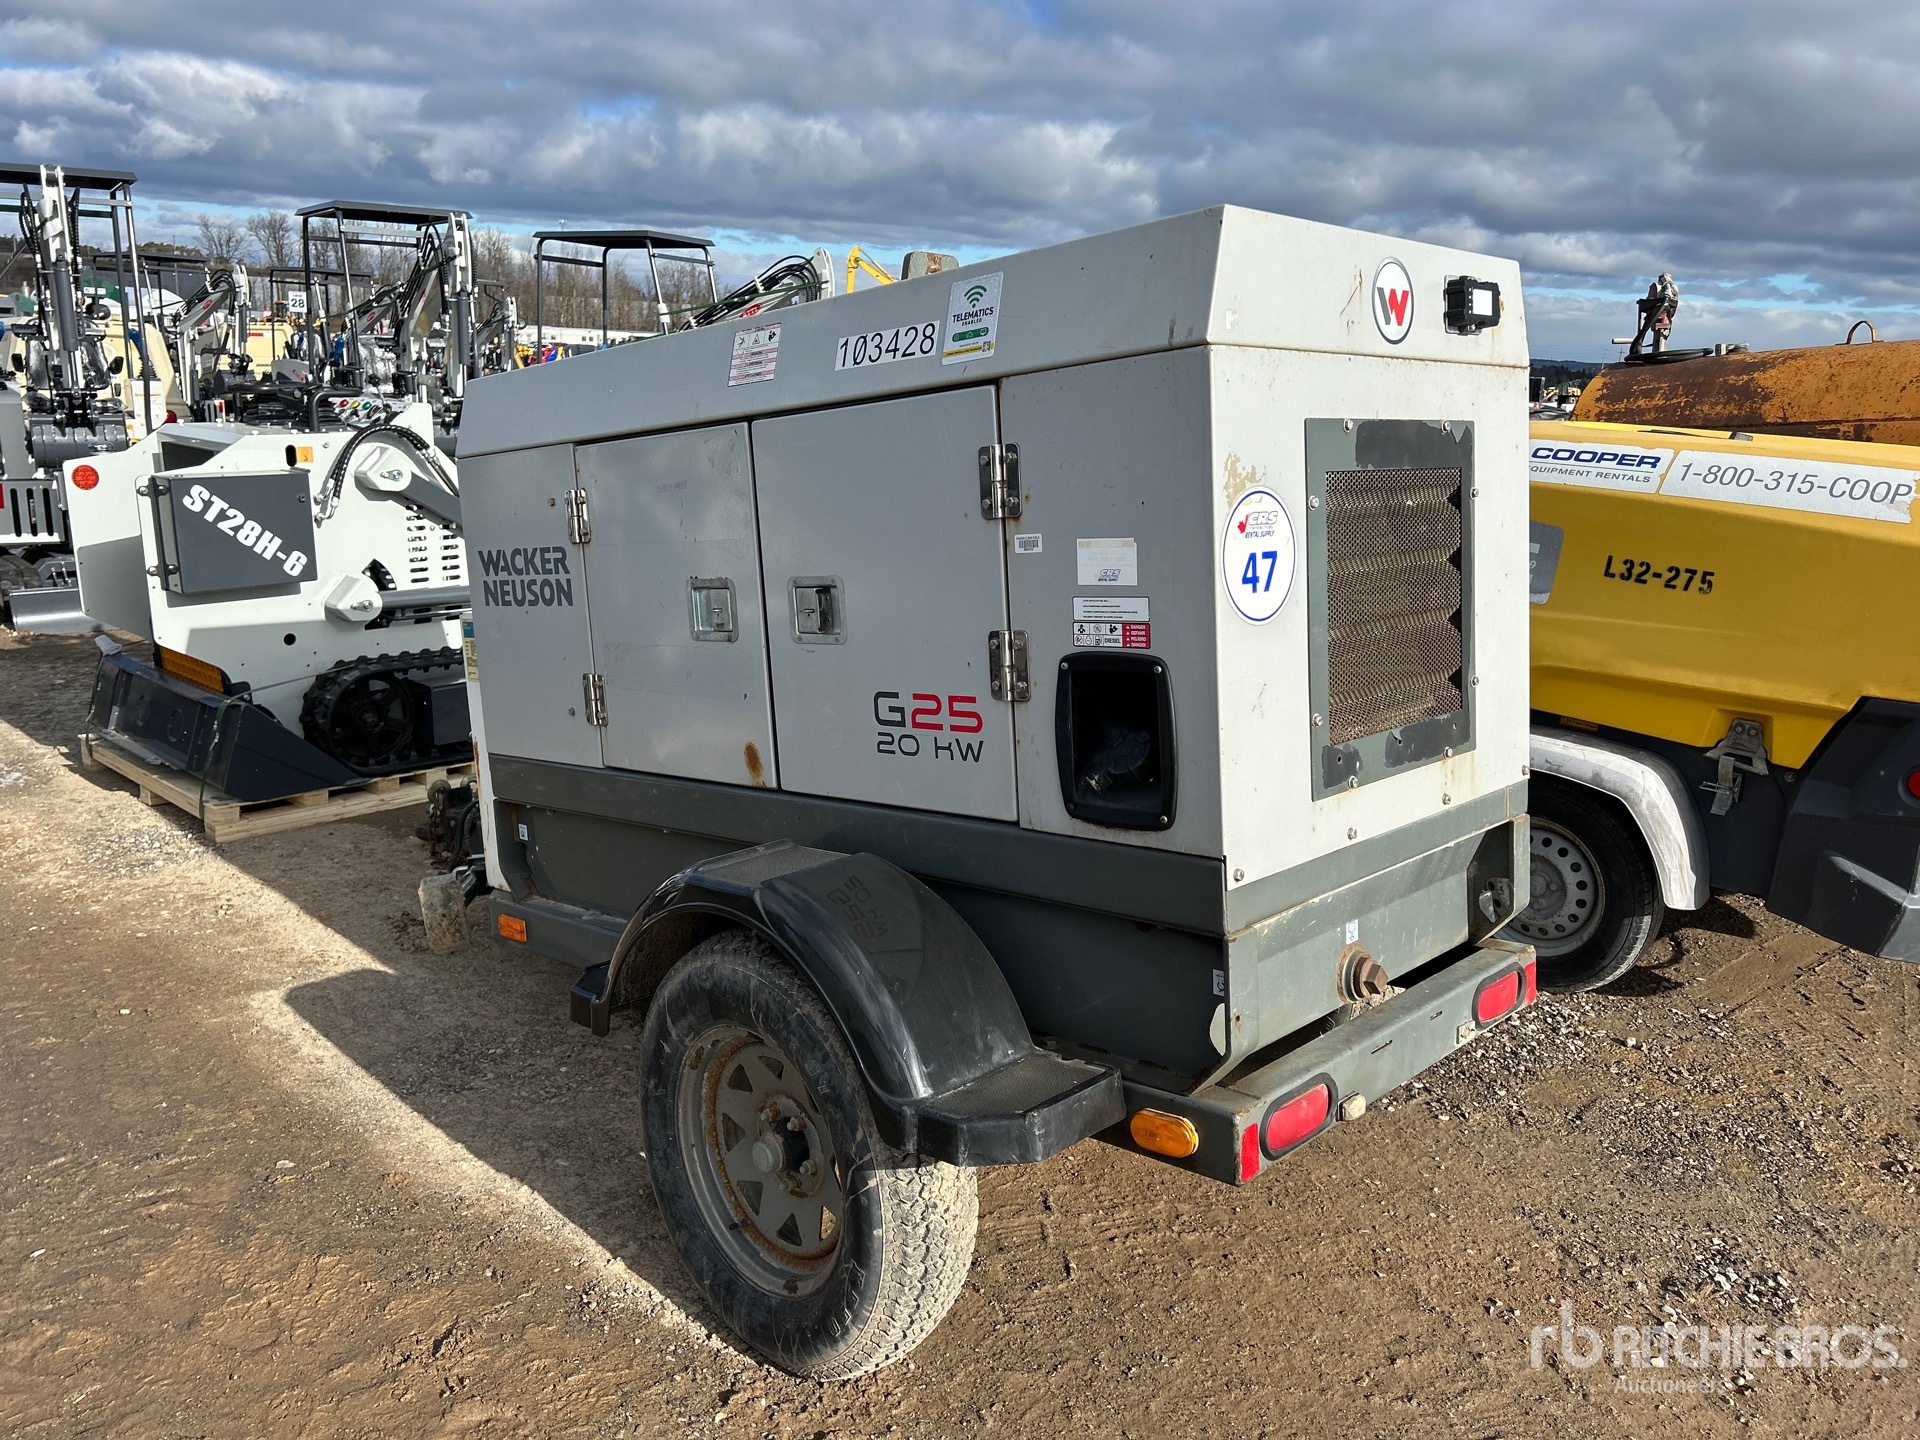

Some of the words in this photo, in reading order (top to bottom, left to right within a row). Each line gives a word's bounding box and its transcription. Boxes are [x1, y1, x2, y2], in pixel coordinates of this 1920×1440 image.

[290, 298, 305, 308] 28
[952, 306, 994, 323] TELEMATICS
[961, 318, 982, 327] ENABLED
[840, 323, 936, 367] 103428
[1530, 447, 1661, 468] COOPER
[1595, 471, 1651, 483] RENTALS
[1679, 462, 1913, 504] 1-800-315-COOP
[182, 484, 308, 577] ST28H-6
[1248, 510, 1278, 526] CRS
[477, 546, 571, 576] WACKER
[1100, 568, 1121, 576] CRS
[1242, 550, 1278, 594] 47
[1603, 555, 1715, 595] L32-275
[483, 578, 574, 607] NEUSON
[873, 691, 983, 734] G25
[877, 731, 920, 757] 20
